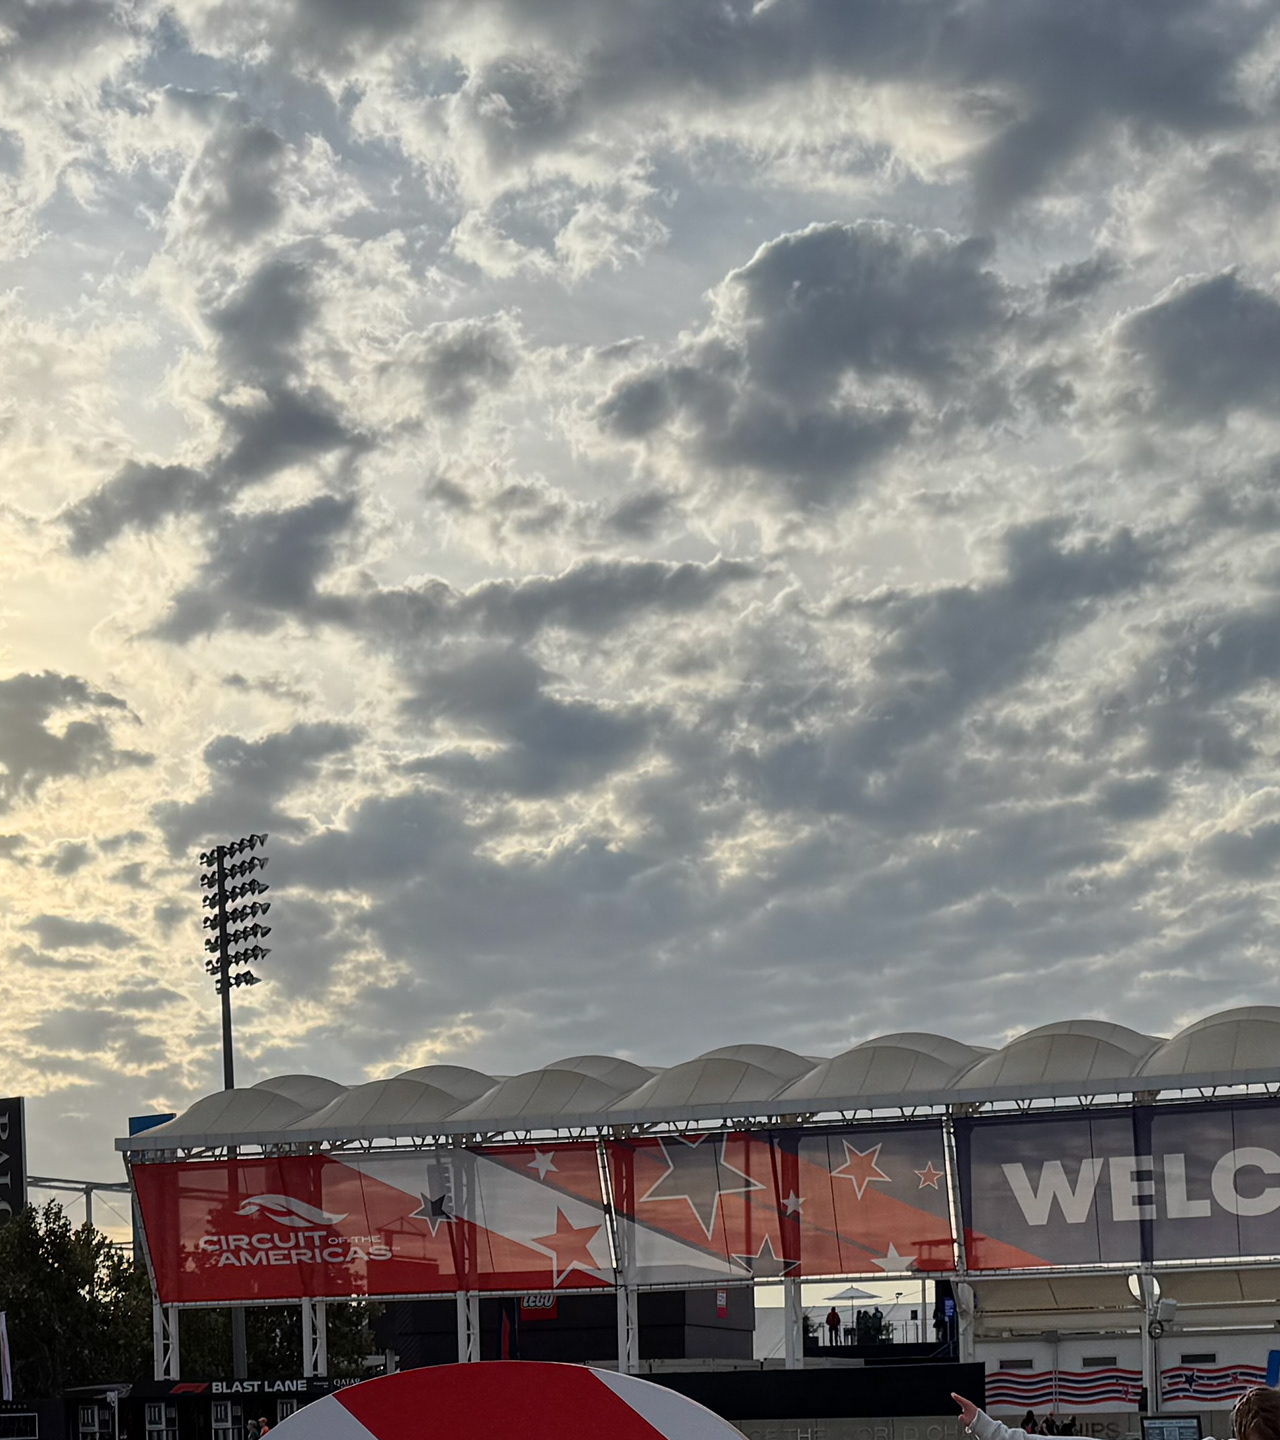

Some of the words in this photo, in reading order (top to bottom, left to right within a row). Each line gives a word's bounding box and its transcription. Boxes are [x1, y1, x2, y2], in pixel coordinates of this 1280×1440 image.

[199, 1231, 327, 1251] CIRCUIT
[328, 1236, 347, 1245] OF
[351, 1235, 382, 1243] THE
[217, 1245, 392, 1267] AMERICAS
[521, 1294, 556, 1309] LEGO
[212, 1381, 261, 1394] BLAST
[264, 1380, 307, 1392] LANE
